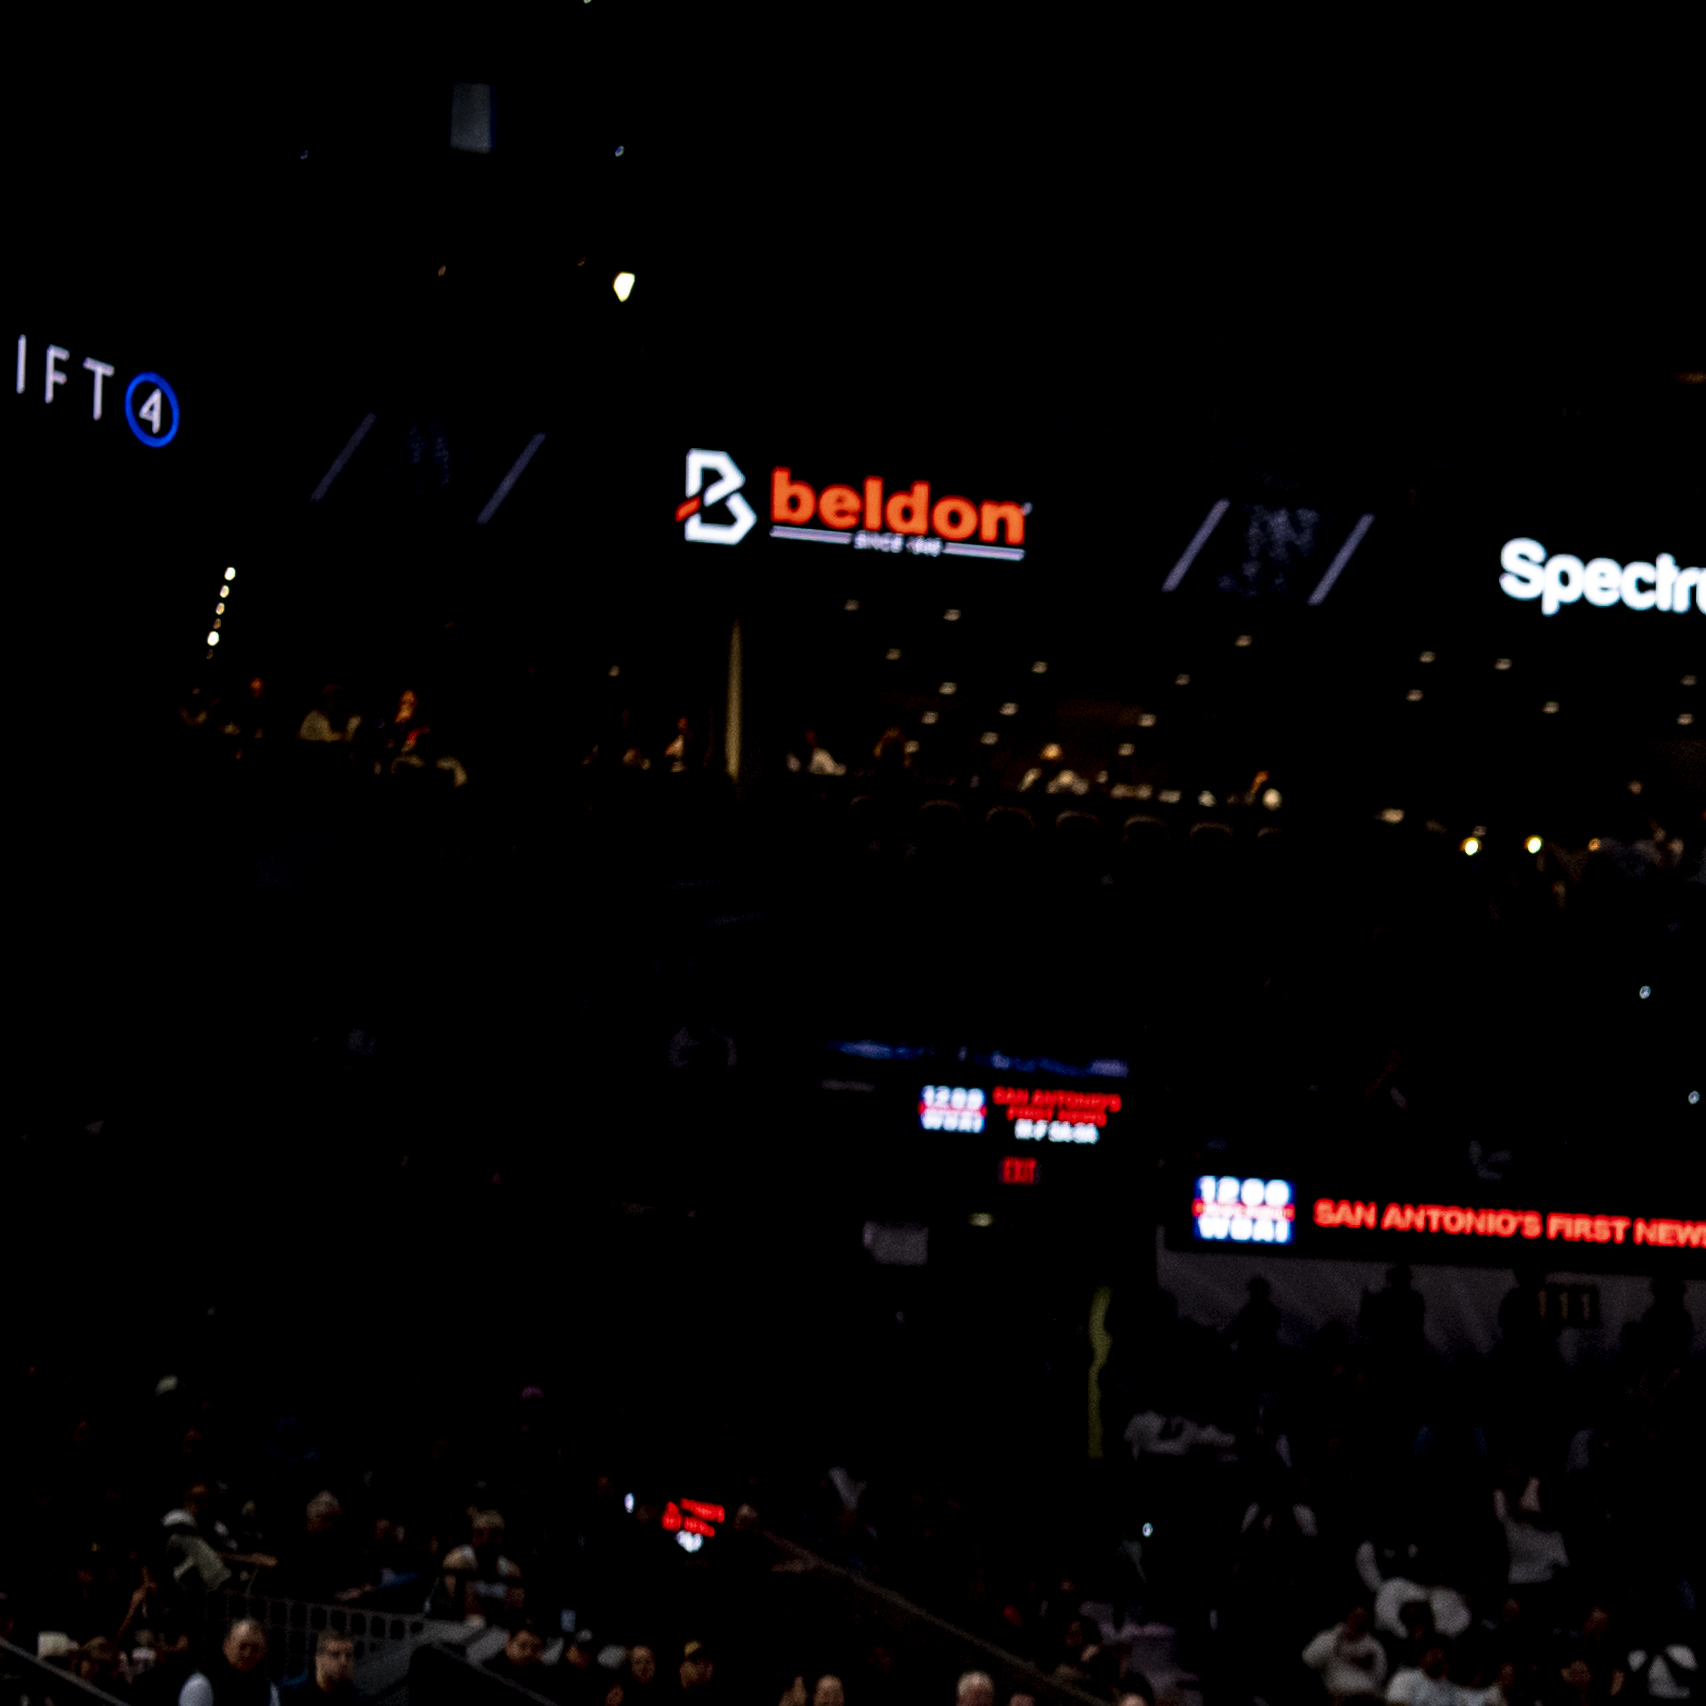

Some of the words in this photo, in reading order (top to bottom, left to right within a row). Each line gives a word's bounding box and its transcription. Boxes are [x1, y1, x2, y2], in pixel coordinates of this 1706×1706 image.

[770, 466, 1026, 545] beldon
[1313, 1197, 1377, 1231] SAN
[1380, 1202, 1543, 1240] ANTONIO'S
[1546, 1211, 1631, 1245] FIRST
